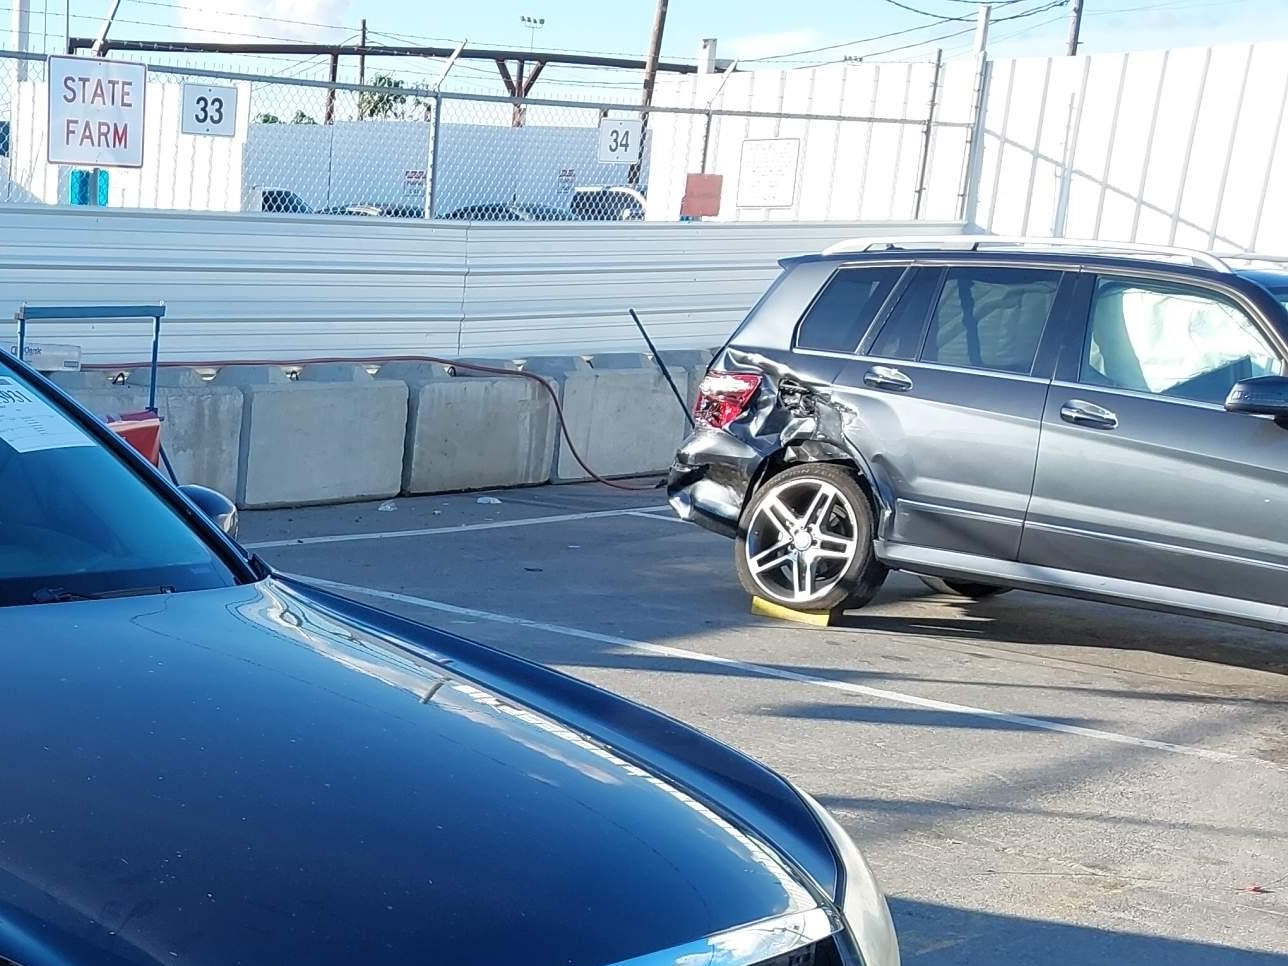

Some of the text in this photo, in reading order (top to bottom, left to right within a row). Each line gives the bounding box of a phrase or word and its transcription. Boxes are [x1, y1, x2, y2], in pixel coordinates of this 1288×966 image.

[63, 76, 133, 107] STATE
[194, 96, 224, 125] 33
[66, 119, 128, 149] FARM
[608, 129, 630, 153] 34
